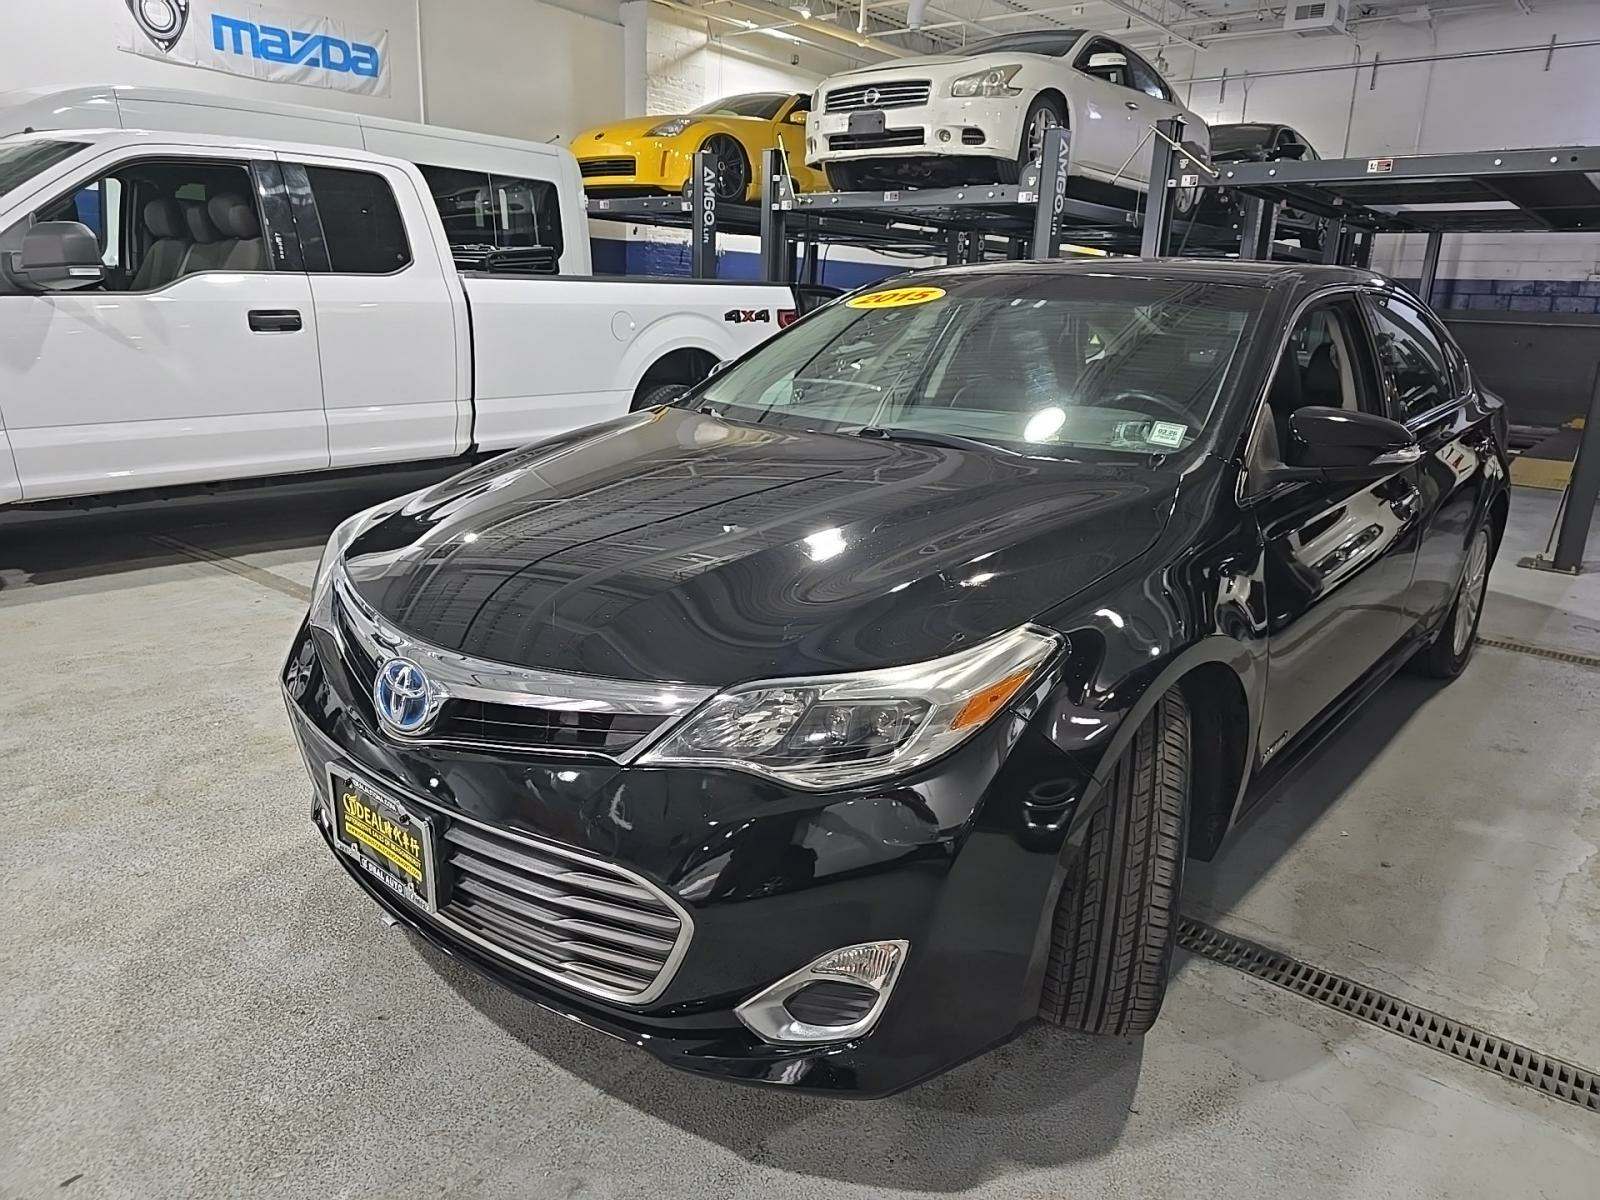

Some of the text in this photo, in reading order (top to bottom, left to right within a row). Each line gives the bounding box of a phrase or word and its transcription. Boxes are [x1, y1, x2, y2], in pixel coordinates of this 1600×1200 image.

[703, 165, 716, 226] AMGO
[1054, 138, 1070, 214] AMGO
[855, 290, 939, 304] 2015
